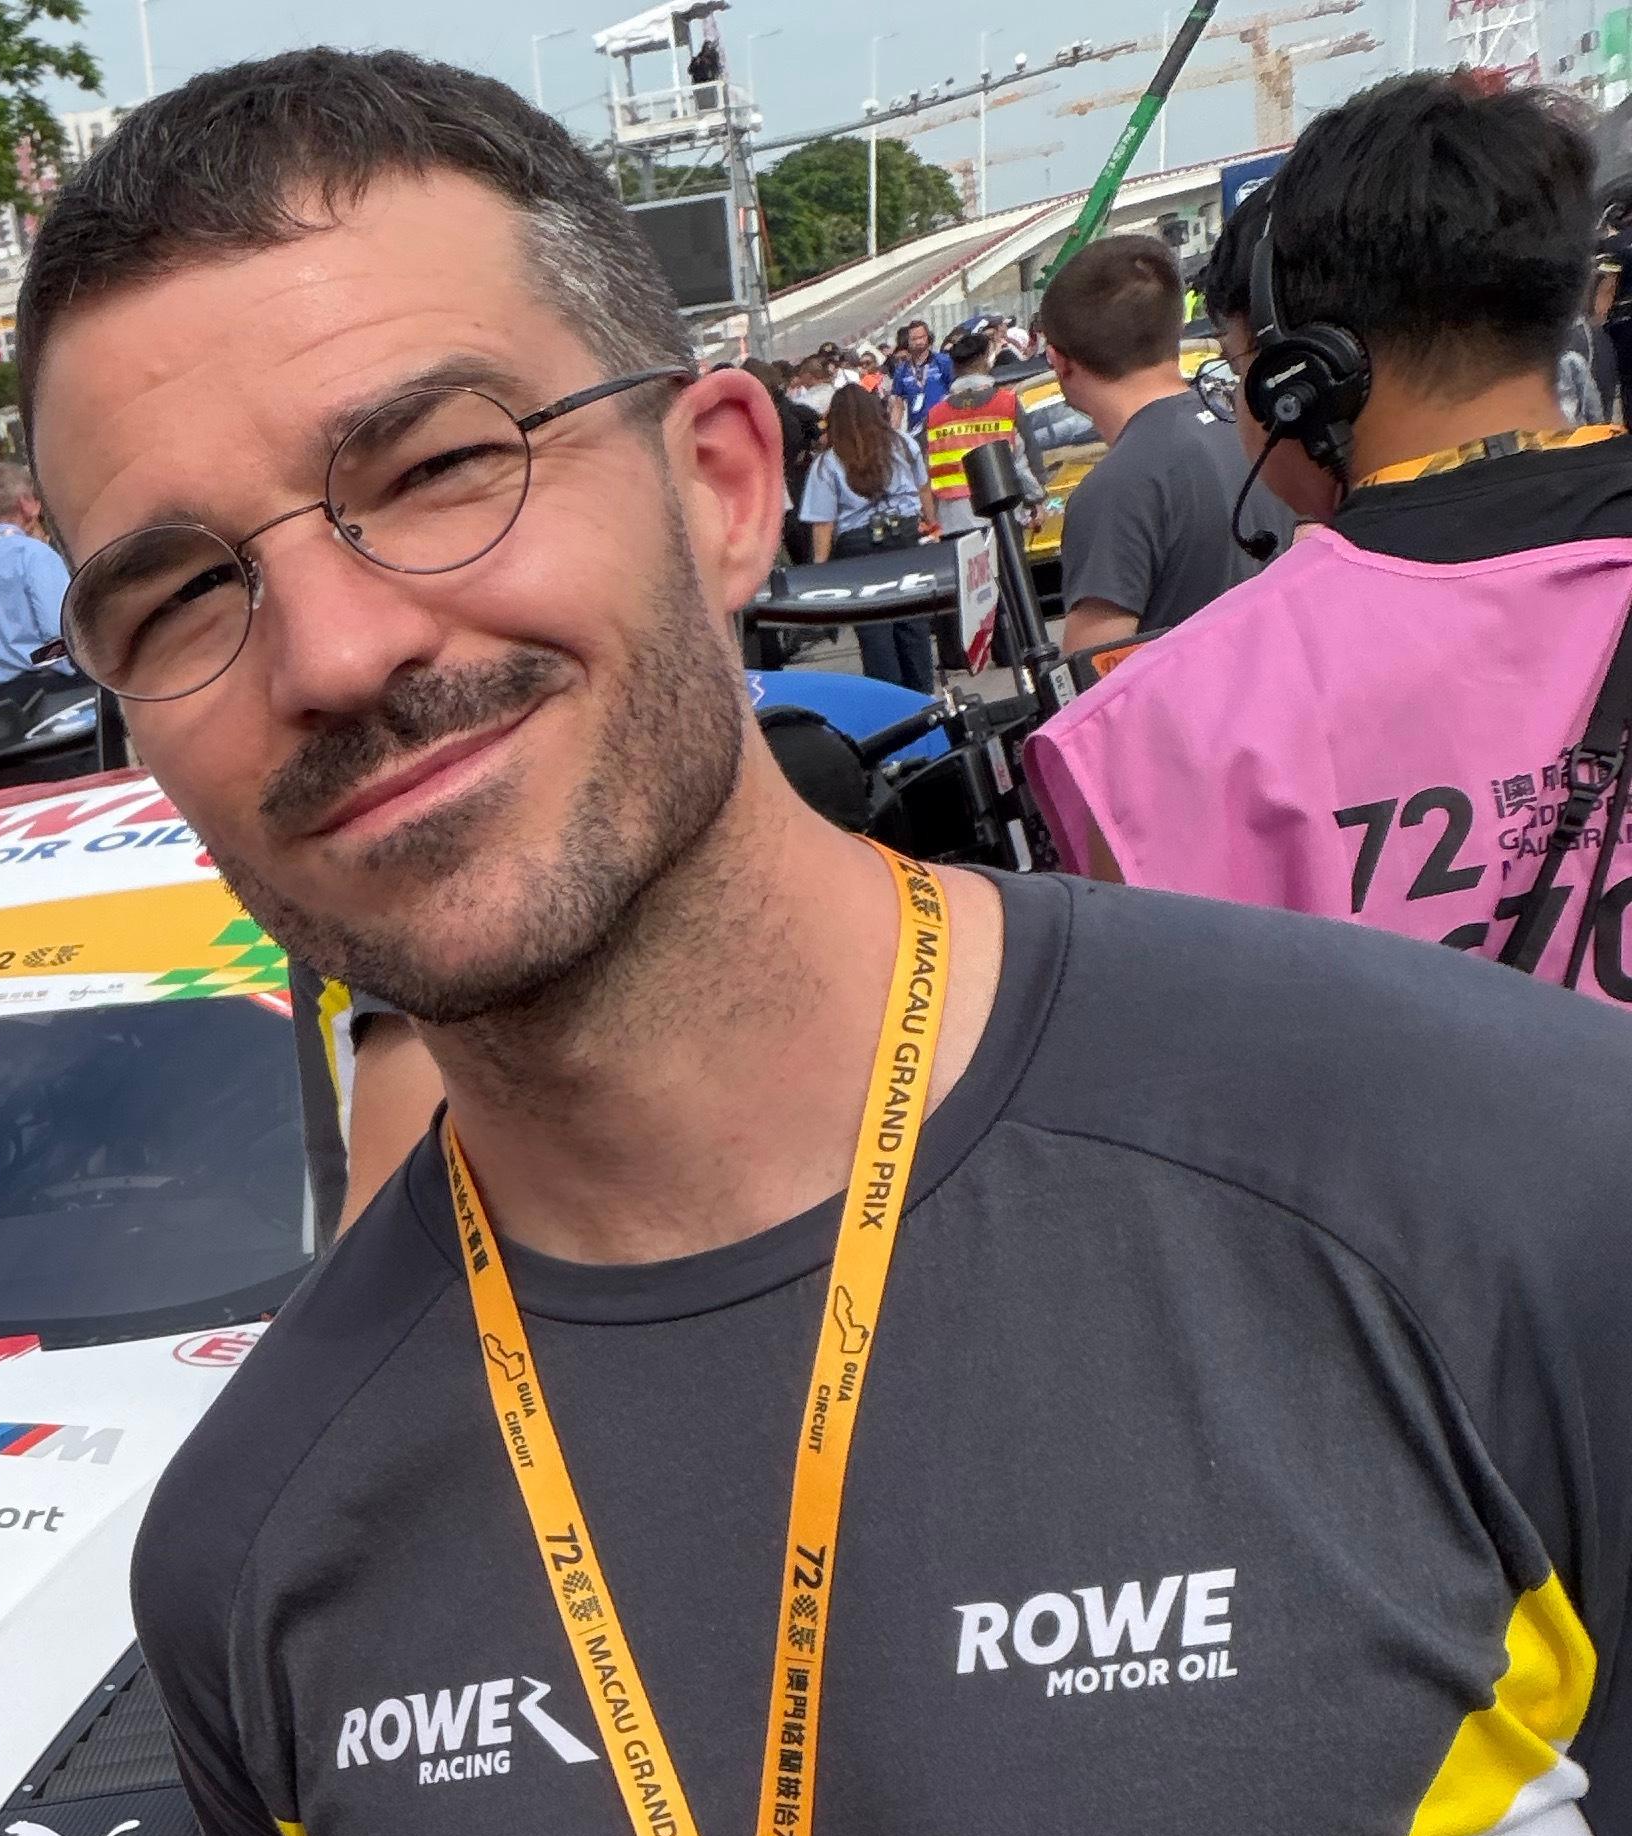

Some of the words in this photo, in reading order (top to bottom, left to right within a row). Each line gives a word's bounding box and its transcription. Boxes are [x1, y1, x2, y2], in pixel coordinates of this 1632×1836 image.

[1333, 786, 1487, 914] 72
[901, 927, 937, 1035] MACAU
[878, 1042, 920, 1153] GRAND
[858, 1161, 896, 1231] PRIX
[516, 1382, 537, 1417] GUIA
[837, 1362, 858, 1403] GUIA
[504, 1411, 534, 1469] CIRCUIT
[808, 1384, 830, 1455] CIRCUIT
[793, 1543, 827, 1591] 72
[545, 1523, 584, 1573] 72
[586, 1634, 638, 1735] MACAU
[952, 1567, 1237, 1675] ROWE
[1046, 1657, 1170, 1698] MOTOR
[1177, 1650, 1239, 1682] OIL
[337, 1677, 514, 1770] ROWE
[419, 1750, 511, 1785] RACING
